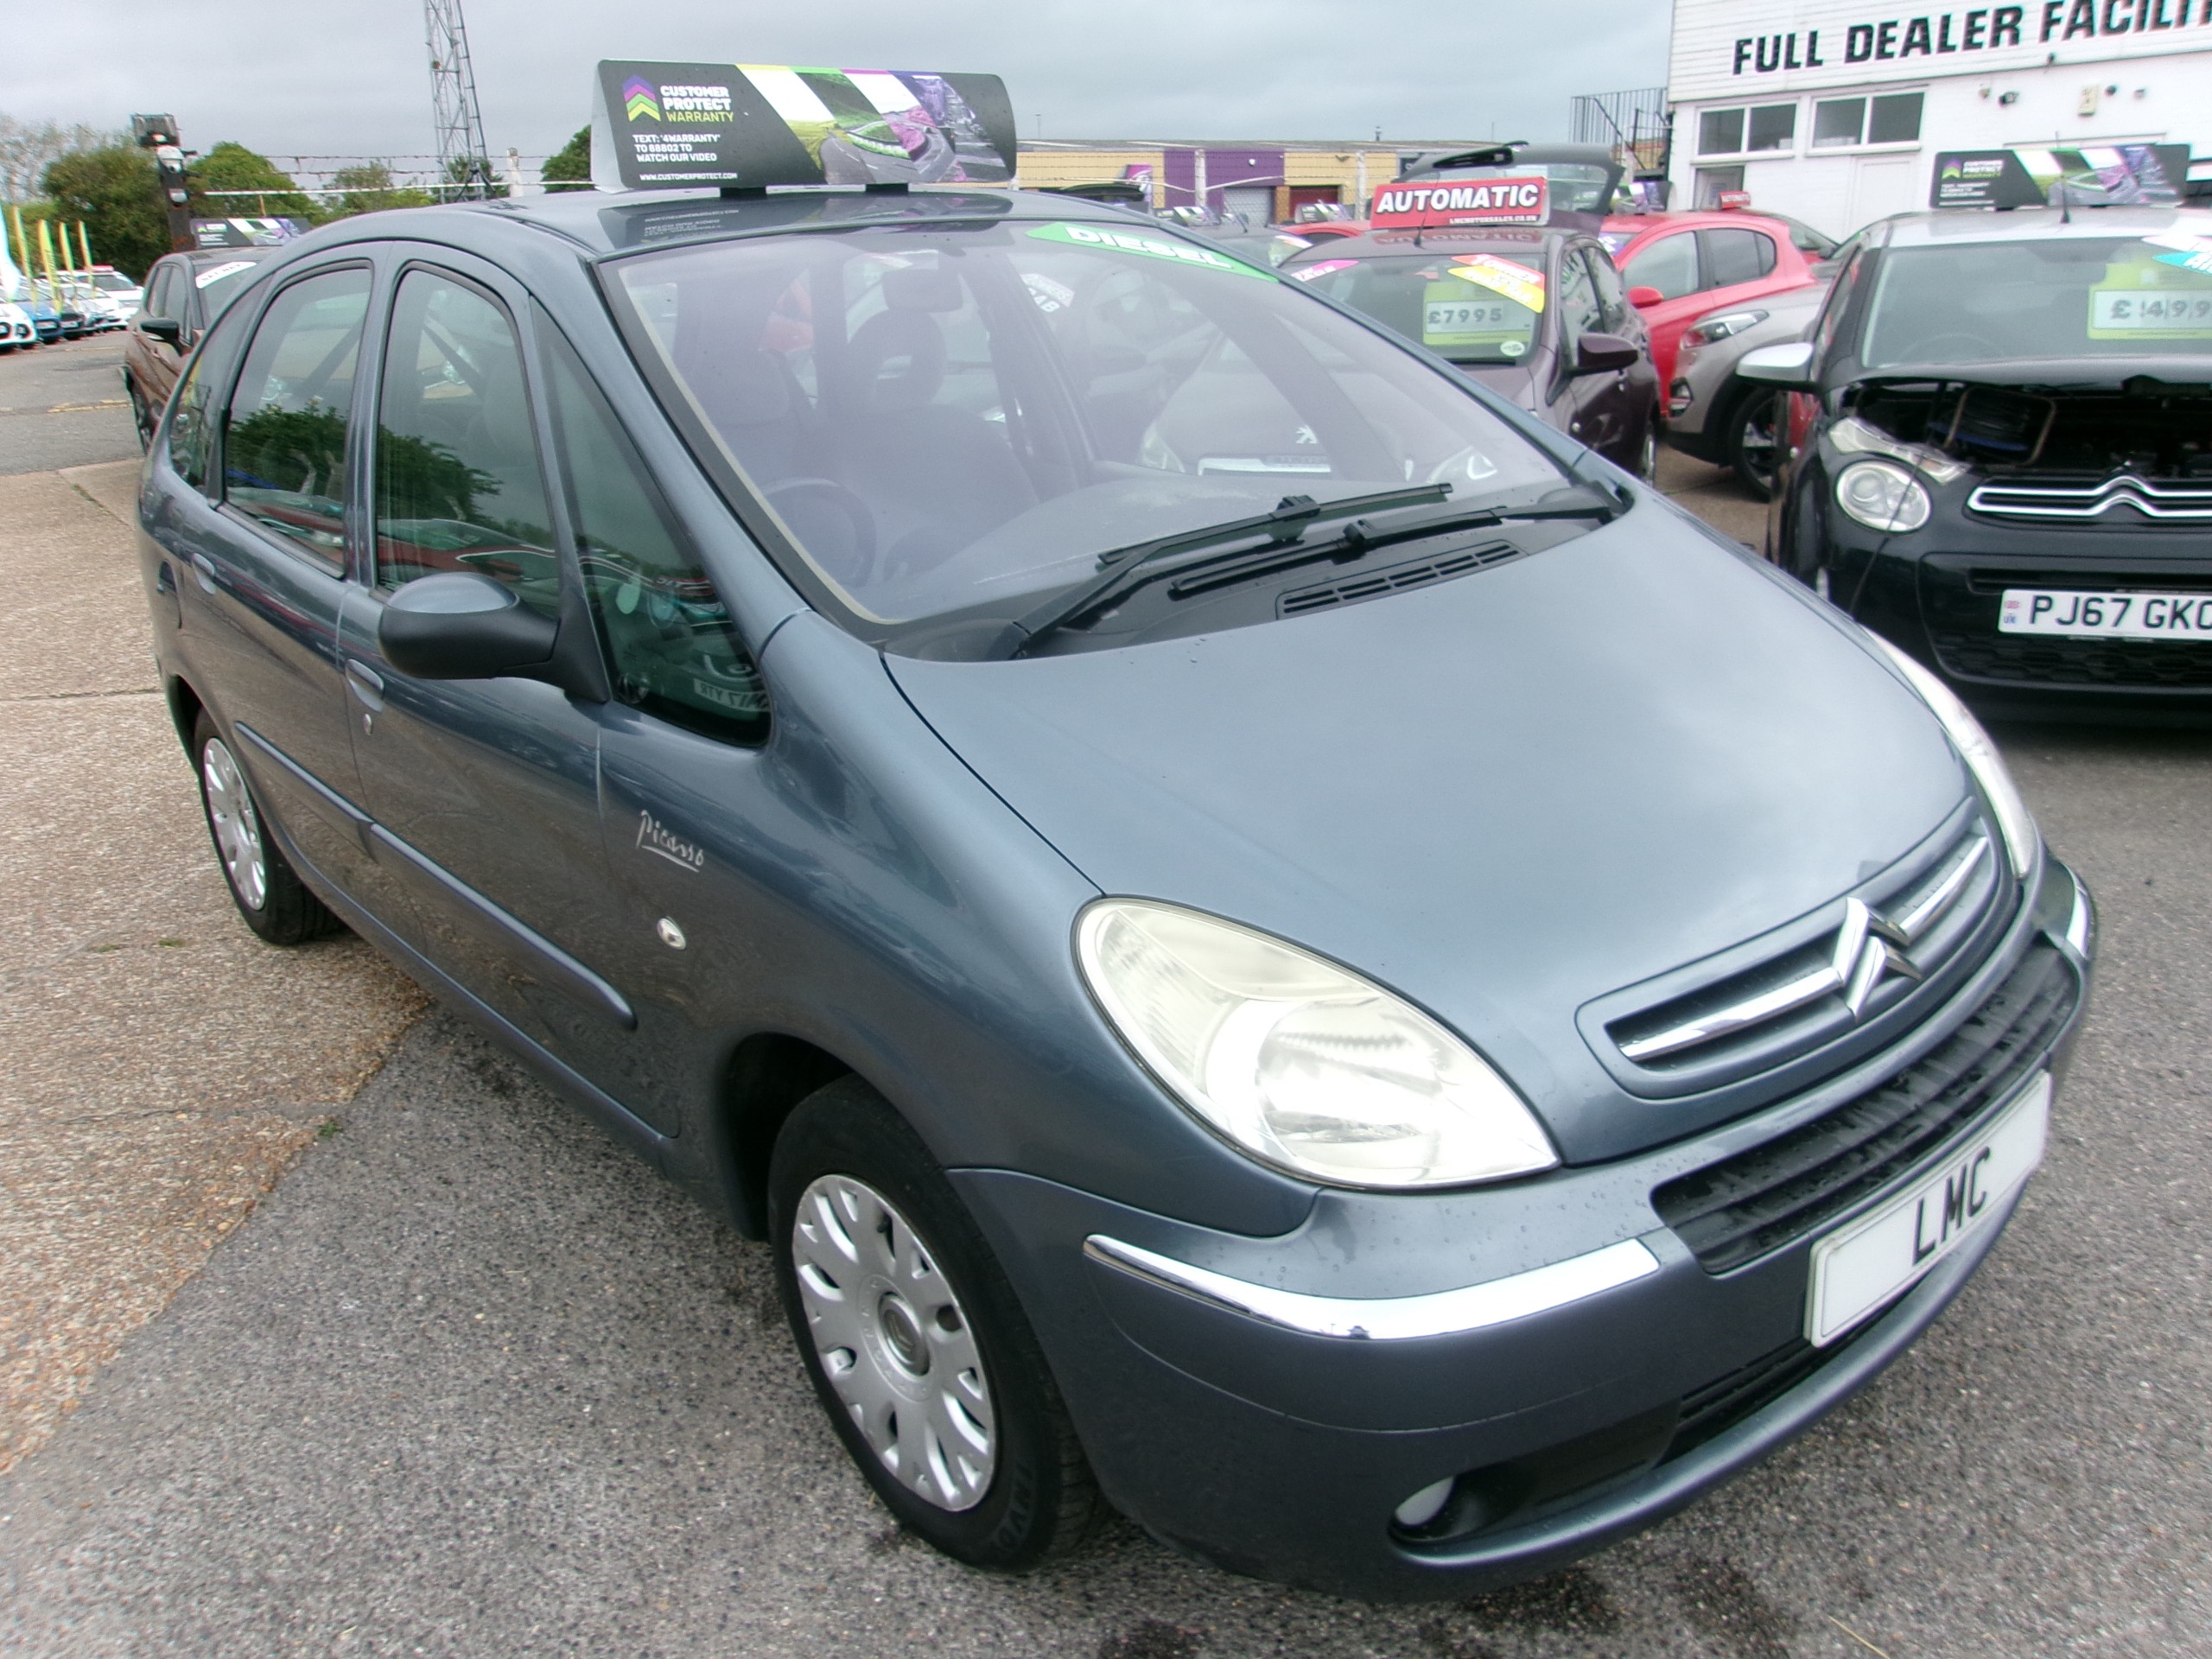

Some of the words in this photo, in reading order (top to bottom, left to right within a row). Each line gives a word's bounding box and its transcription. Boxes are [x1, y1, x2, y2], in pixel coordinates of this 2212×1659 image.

[1732, 30, 1825, 75] FULL
[1842, 6, 2024, 64] DEALER
[659, 86, 730, 97] CUSTOMER
[663, 98, 732, 111] PROTECT
[665, 111, 734, 123] WARRANTY
[632, 134, 660, 143] TEXT:
[634, 144, 647, 153] TO
[648, 144, 678, 153] 88802
[636, 154, 669, 162] WATCH
[670, 154, 689, 162] OUR
[690, 153, 717, 162] VIDEO
[1376, 184, 1540, 213] AUTOMATIC
[1065, 226, 1232, 269] DIESEL
[1427, 308, 1503, 325] £7995
[2029, 594, 2133, 627] PJ67
[636, 809, 704, 867] Picasso
[1911, 1145, 1991, 1267] LMC
